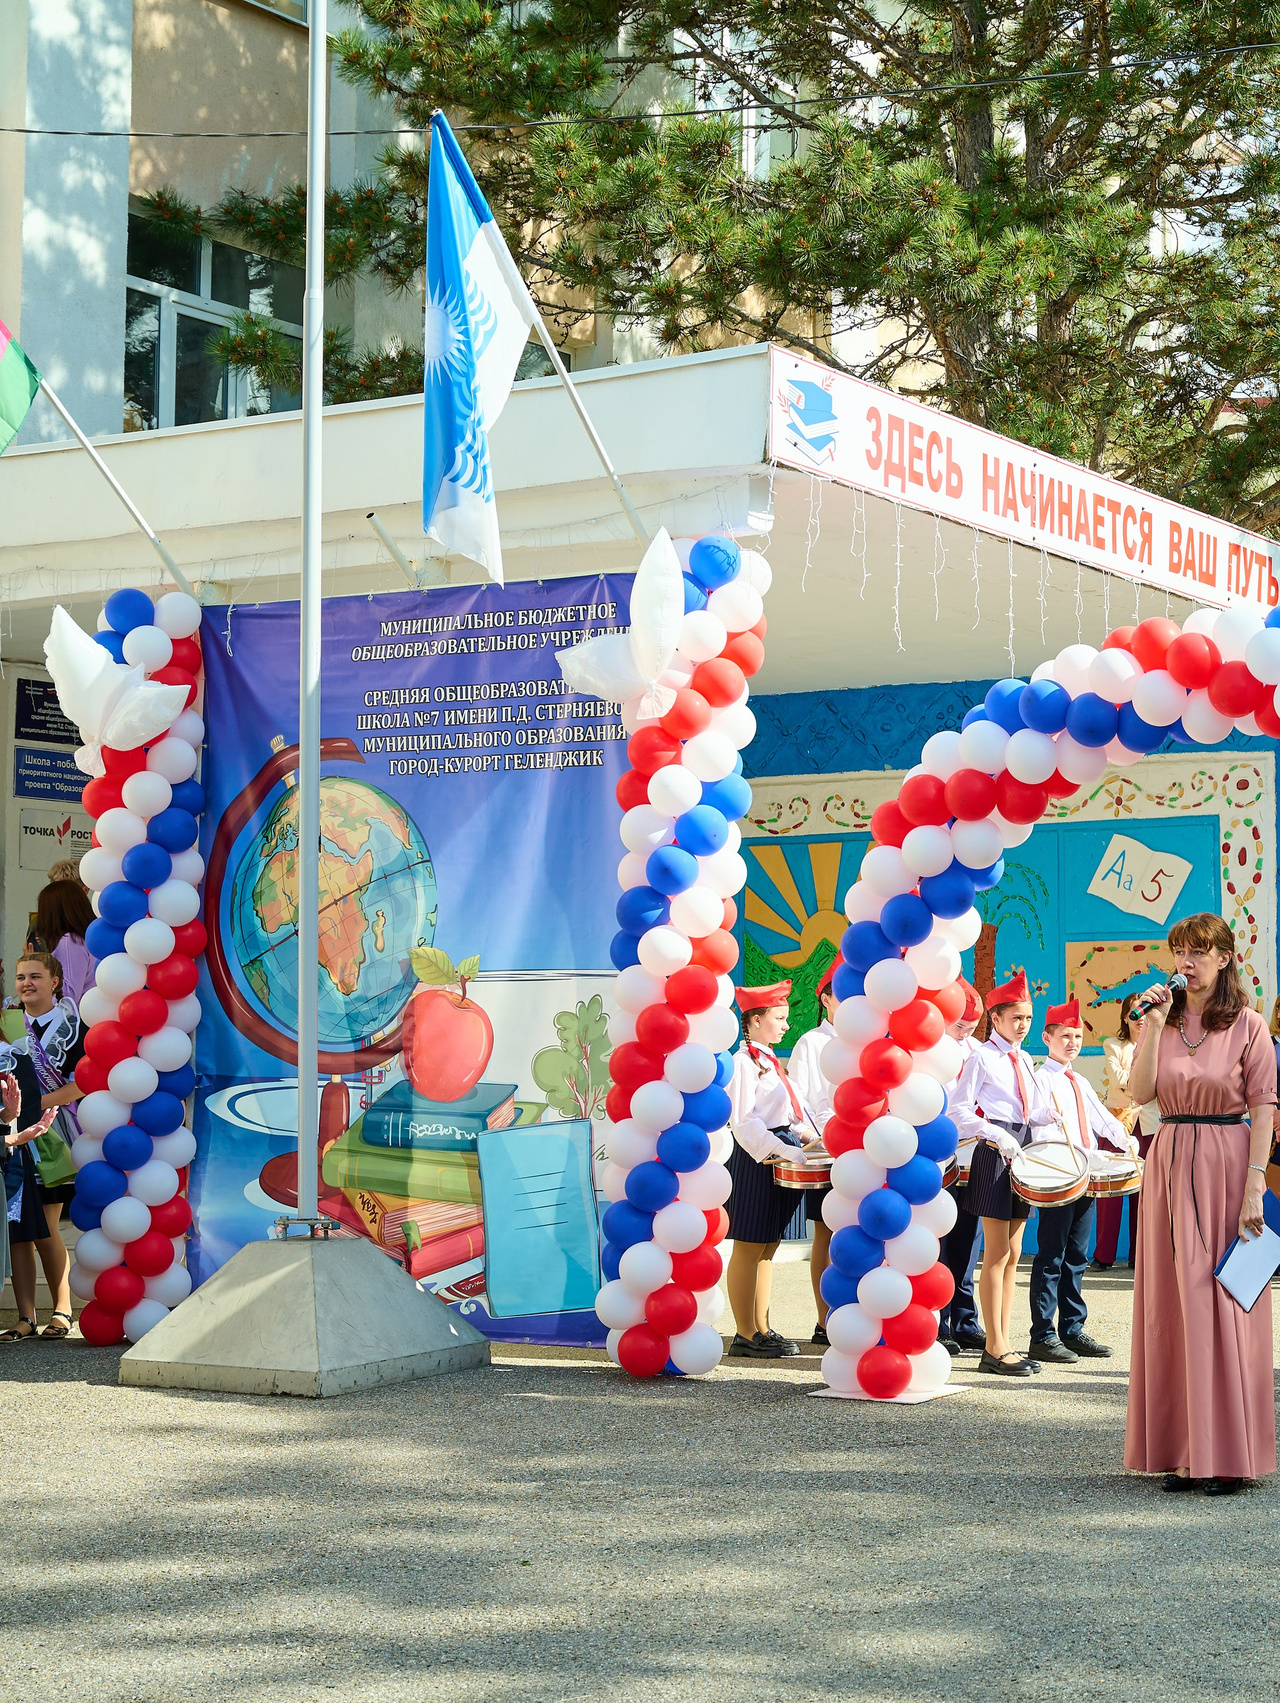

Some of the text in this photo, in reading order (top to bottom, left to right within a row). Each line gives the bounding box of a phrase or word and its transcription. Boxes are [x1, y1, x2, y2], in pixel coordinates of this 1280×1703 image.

[865, 406, 963, 499] ЗДЕСЬ
[982, 452, 1153, 566] НАЧИНАЕТСЯ
[1168, 520, 1218, 588] ВАШ
[1227, 541, 1279, 607] ПУТЬ
[379, 602, 617, 637] МУНИЦИПАЛЬНОЕ БЮДЖЕТНОЕ
[351, 626, 631, 662] ОБЩЕОБРАЗОВАТЕЛЬНОЕ УЧРЕЖ
[364, 680, 579, 708] СРЕДНЯЯ ОБЩЕОБРАЗОВАТ
[356, 712, 411, 730] ШКОЛА
[414, 710, 440, 727] №7
[443, 707, 498, 726] ИМЕНИ
[502, 705, 531, 725] П.Д.
[363, 724, 627, 754] МУНИЦИПАЛЬНОГО ОБРАЗОВАНИЯ
[18, 767, 63, 779] приоритетного
[25, 754, 51, 767] Школа
[389, 749, 604, 777] ГОРОД-КУРОРТ ГЕЛЕНДЖИК
[24, 780, 51, 790] проекта
[23, 825, 55, 837] ТОЧКА
[1141, 868, 1174, 902] 5
